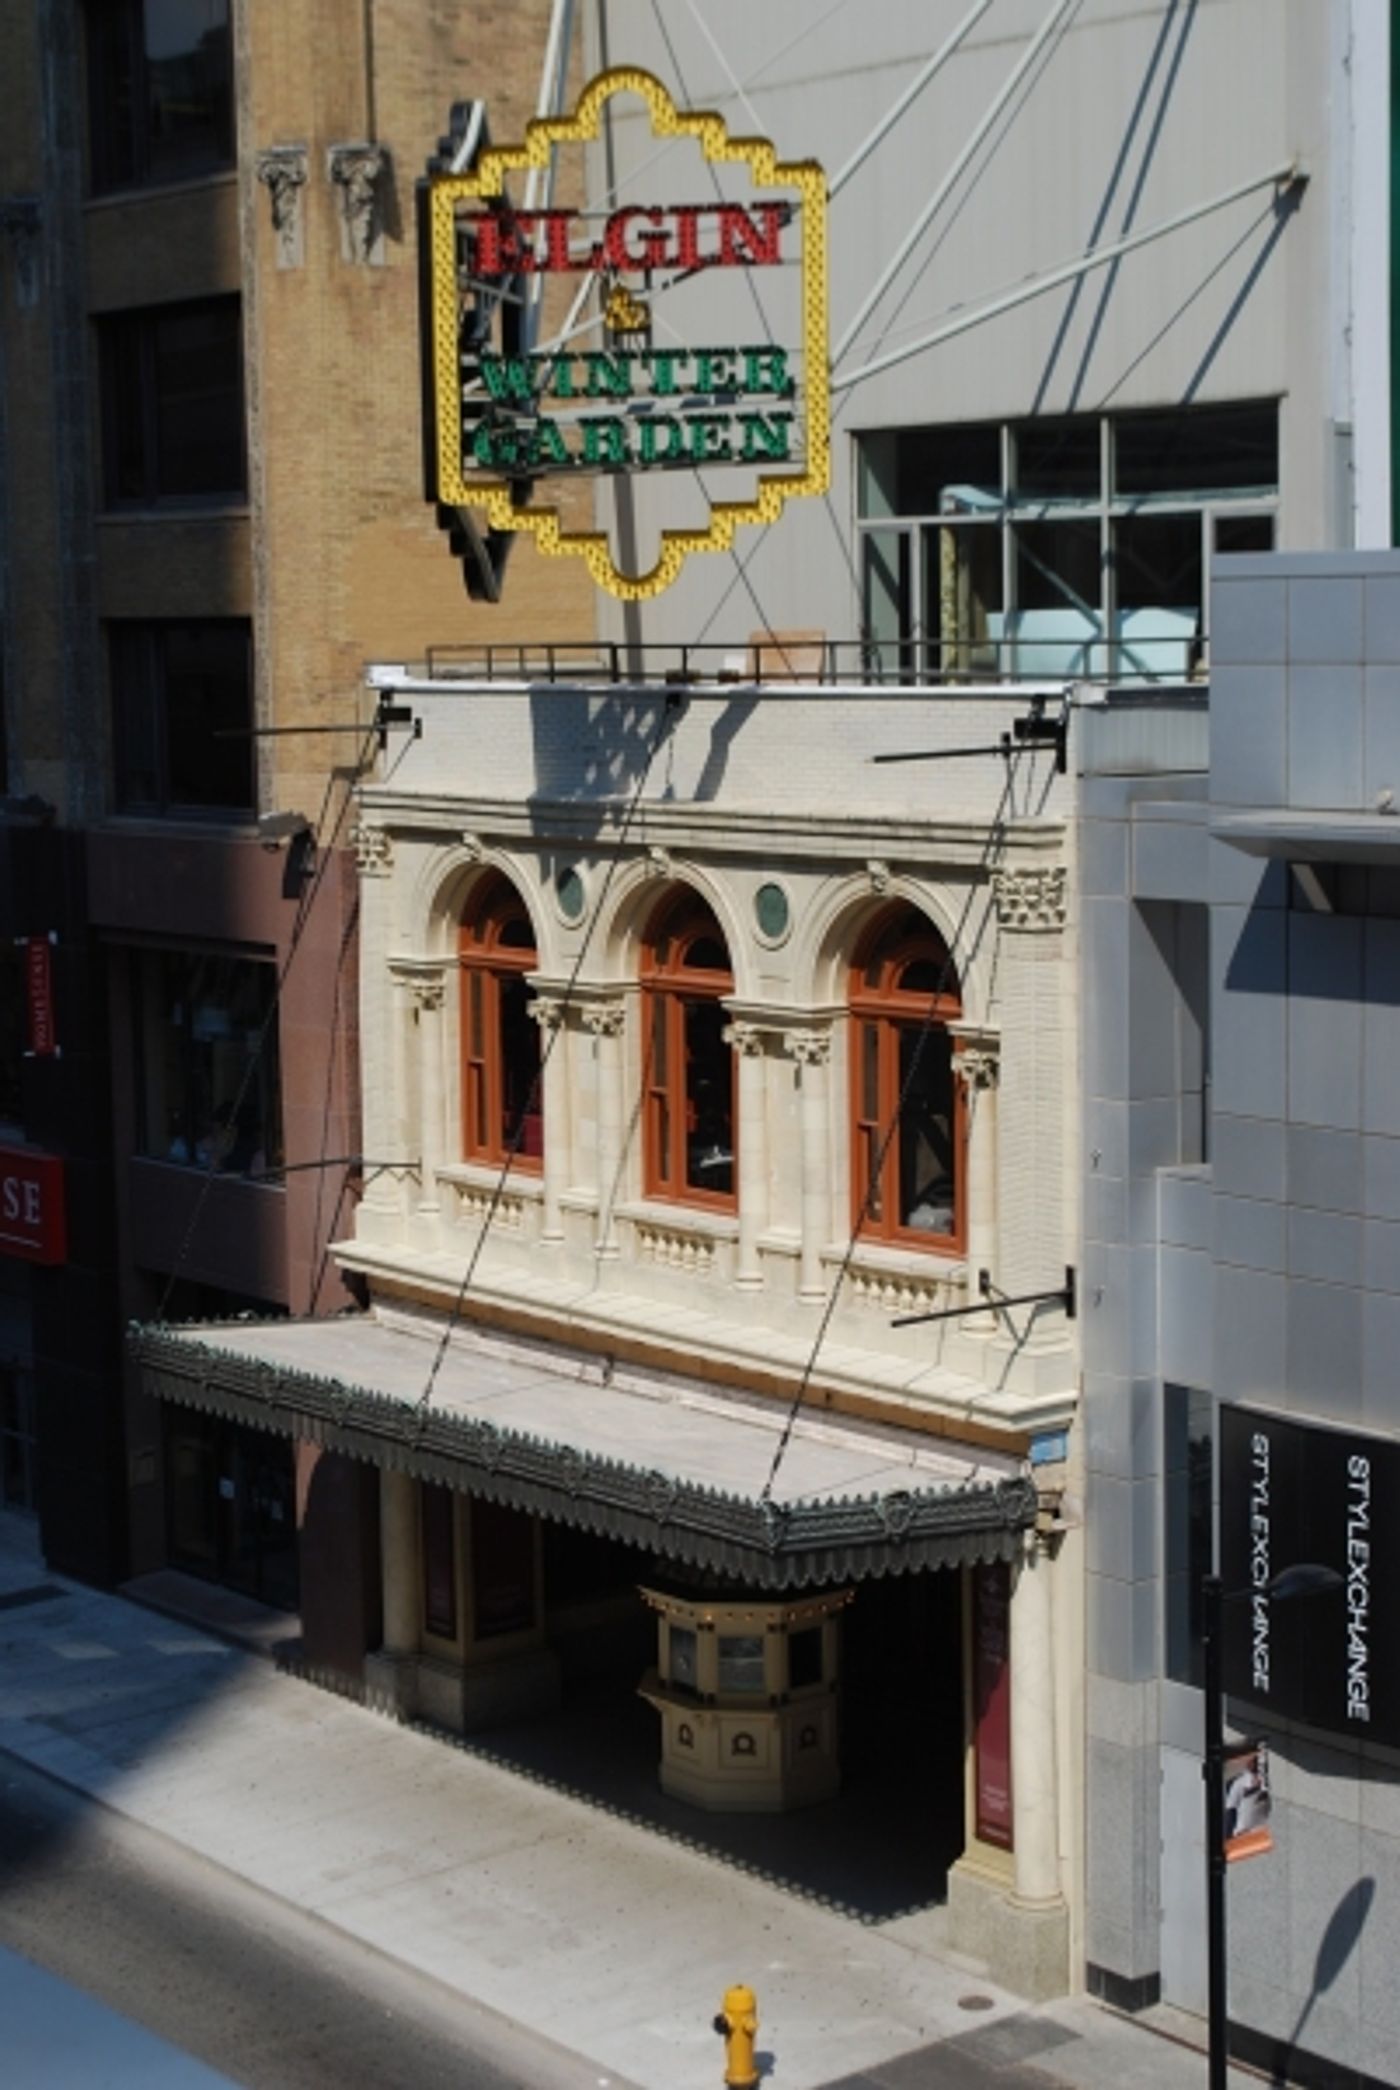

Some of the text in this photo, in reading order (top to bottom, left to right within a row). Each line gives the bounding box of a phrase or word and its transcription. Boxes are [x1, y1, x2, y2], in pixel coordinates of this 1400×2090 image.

[470, 202, 788, 275] ELGIN
[480, 345, 794, 398] WINTER
[473, 411, 794, 466] GARDEN
[1347, 1454, 1370, 1722] STYLEXCHANGE
